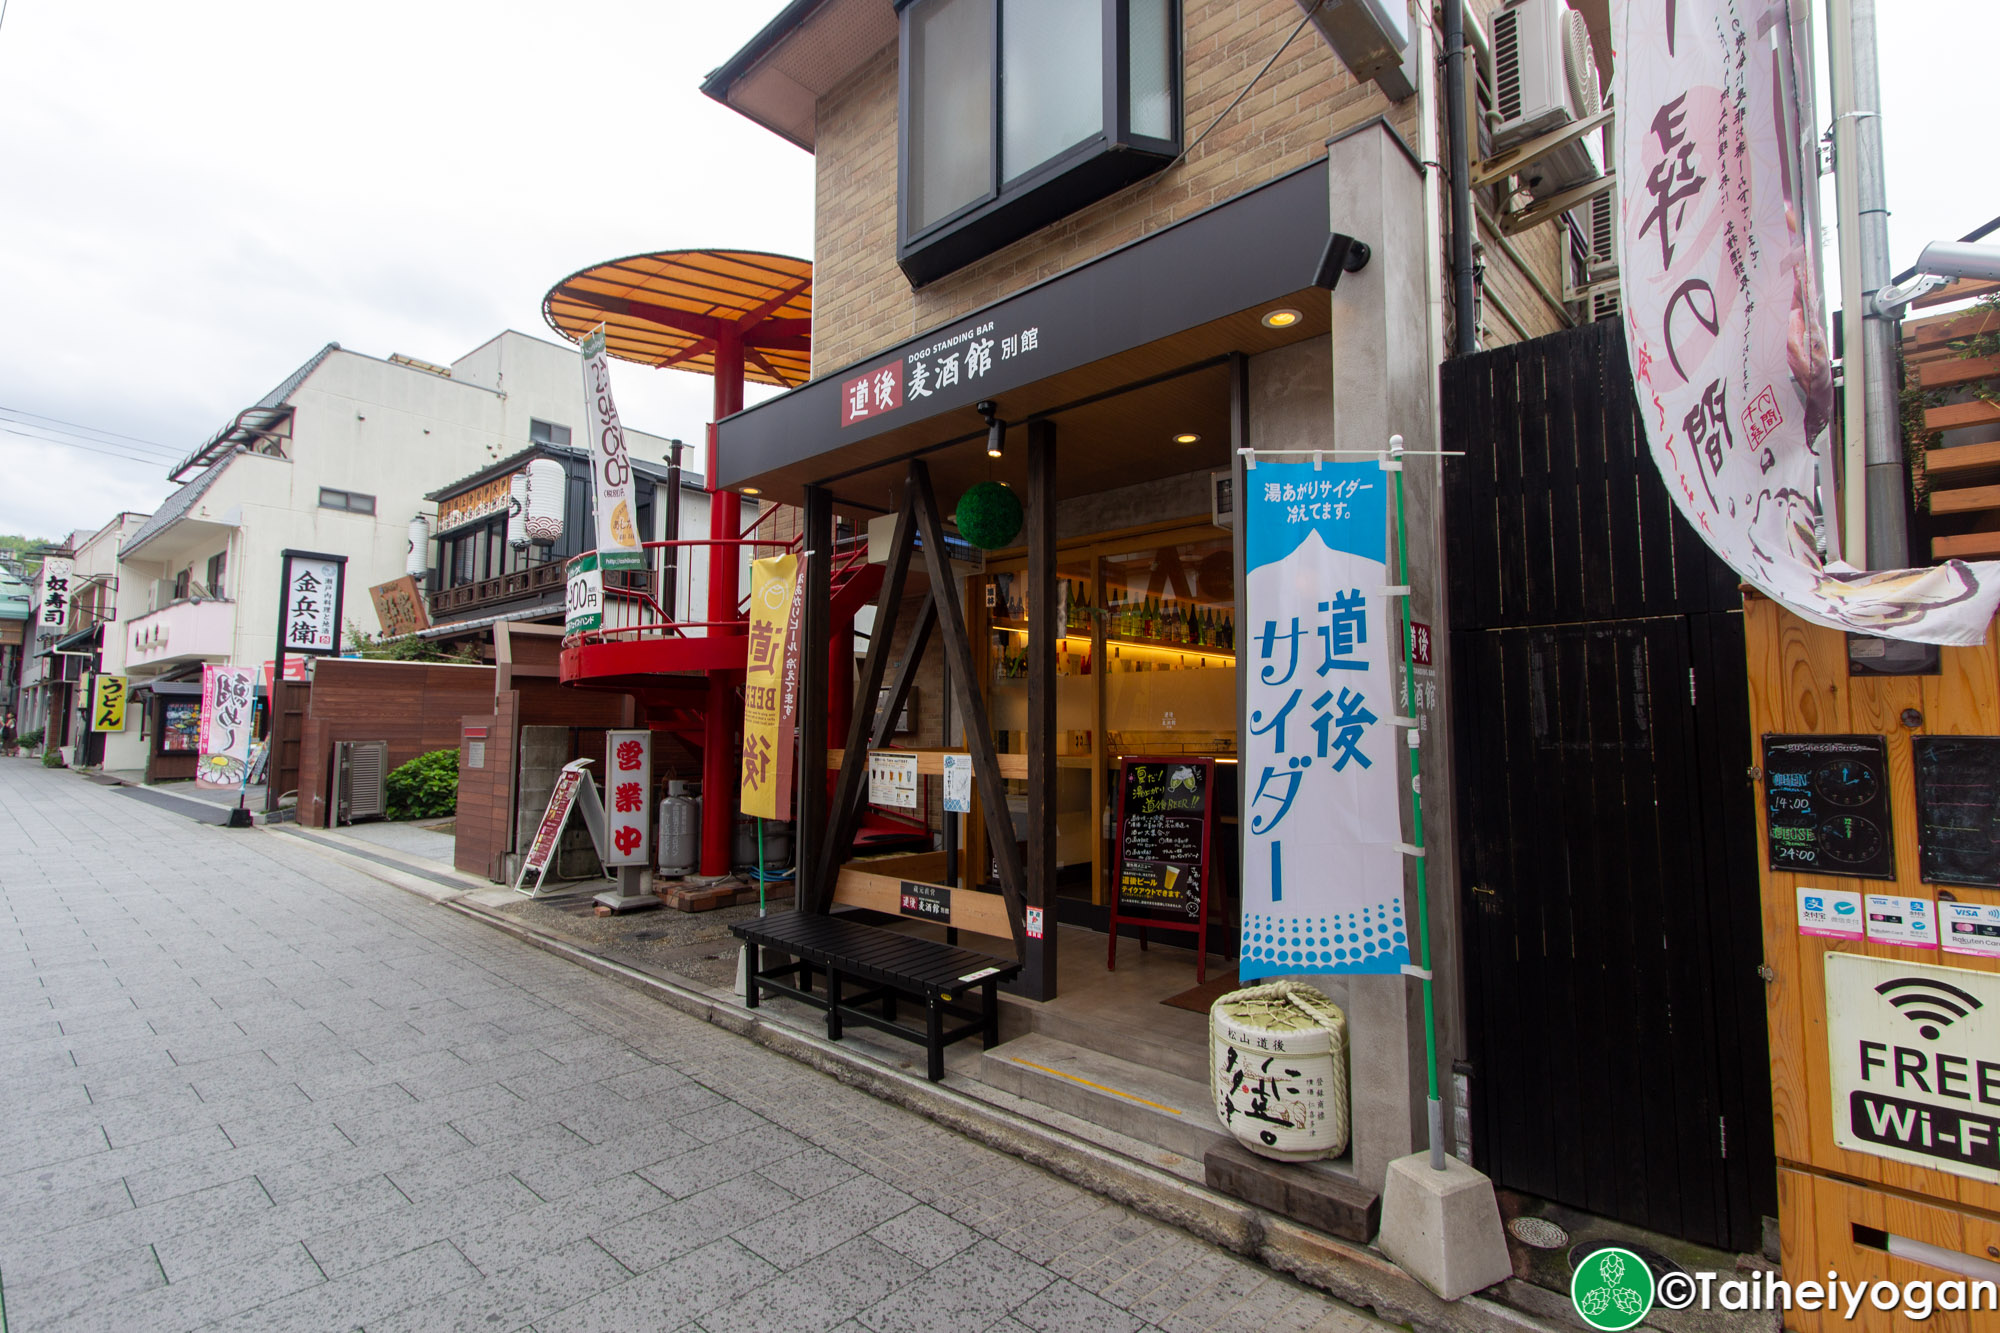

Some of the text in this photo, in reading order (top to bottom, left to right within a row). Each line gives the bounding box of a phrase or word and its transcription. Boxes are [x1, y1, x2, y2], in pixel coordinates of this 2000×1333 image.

[908, 321, 995, 364] DOGO STANDING BAR
[850, 327, 1039, 420] 道後 麦酒館 別館
[1264, 479, 1374, 503] 湯あがりサイダー
[1286, 502, 1352, 524] 冷えてます。
[44, 575, 69, 626] 奴寿司
[289, 570, 322, 645] 金兵衛
[1310, 588, 1379, 773] 道後
[98, 678, 123, 727] うどん
[1250, 616, 1312, 902] サイダー
[1773, 773, 1808, 787] OPEN
[615, 740, 644, 857] 営業中
[1775, 797, 1809, 810] 14:00
[1773, 827, 1815, 841] CLOSE
[1780, 848, 1815, 861] 24:00
[1954, 908, 1979, 918] VISA
[1952, 936, 1985, 945] Rakuten
[1228, 1027, 1286, 1053] 松山道後
[1859, 1040, 2000, 1107] FREE
[1864, 1099, 2000, 1161] Wi-F
